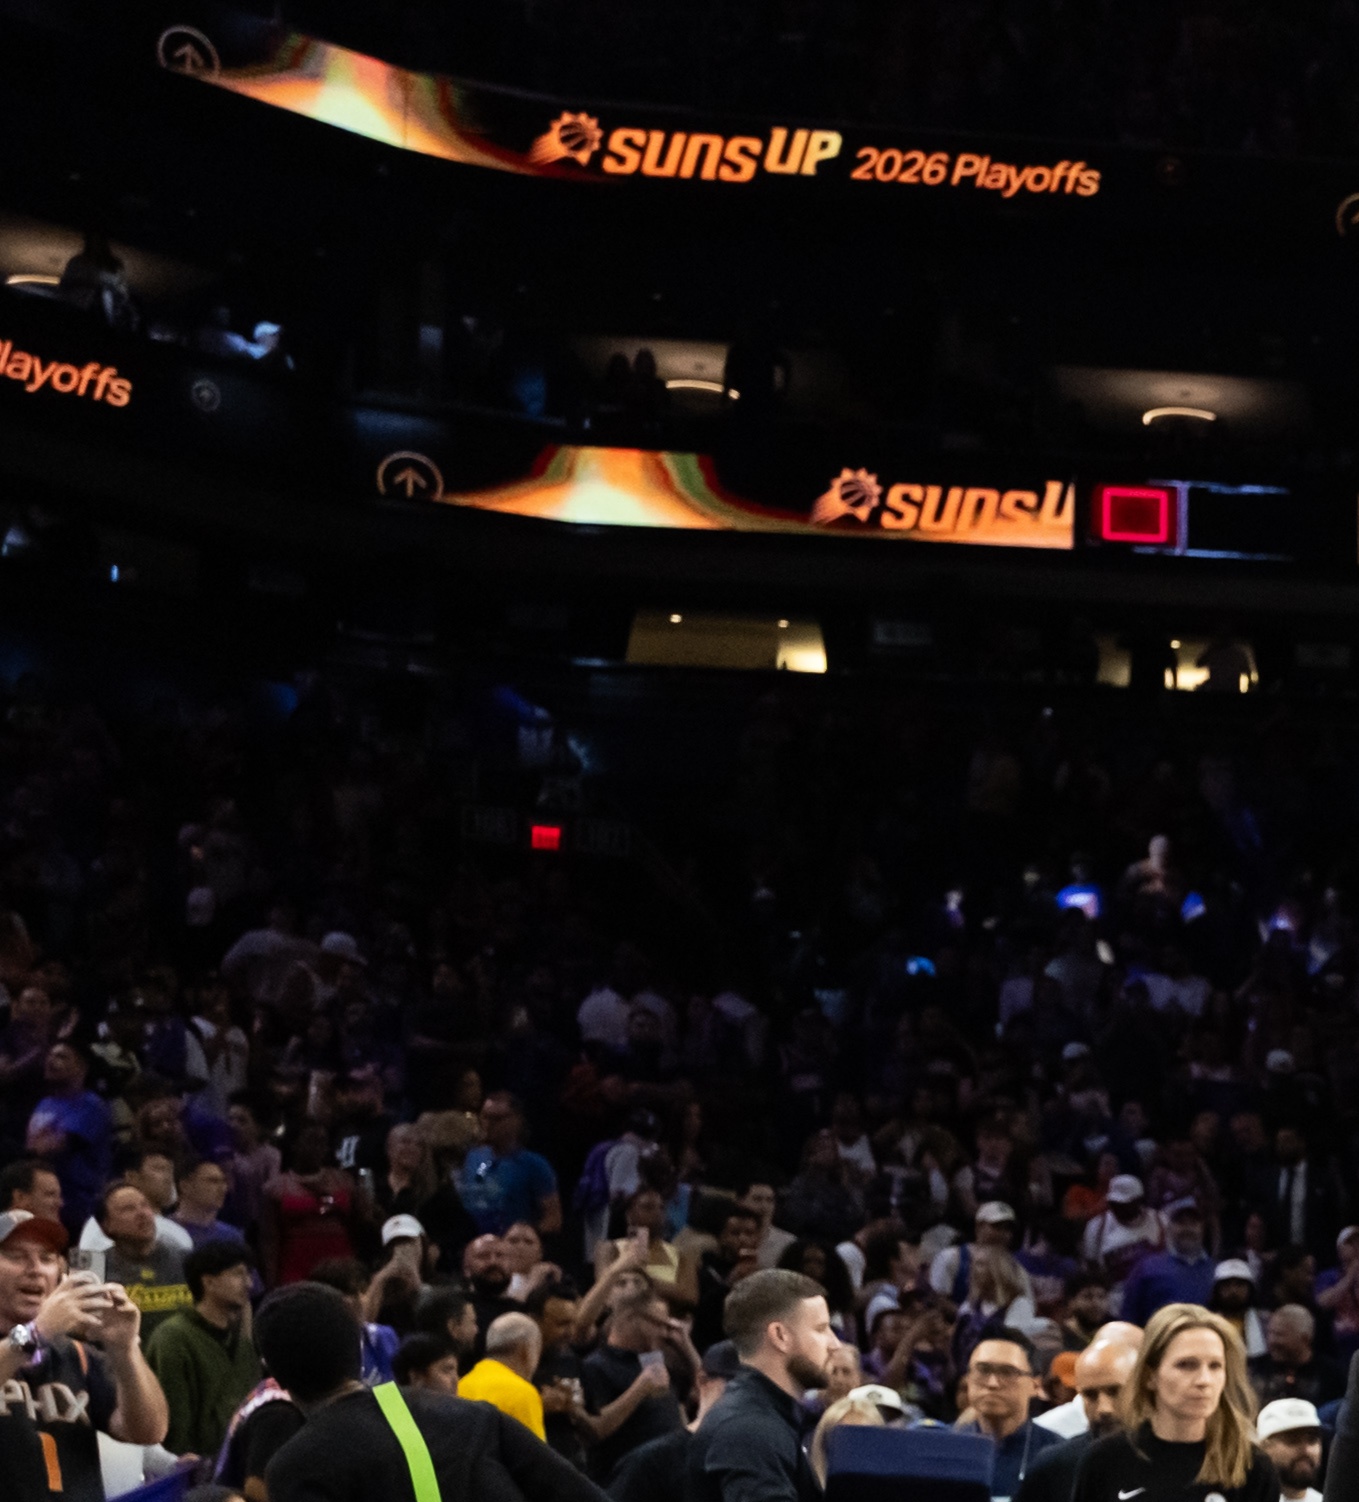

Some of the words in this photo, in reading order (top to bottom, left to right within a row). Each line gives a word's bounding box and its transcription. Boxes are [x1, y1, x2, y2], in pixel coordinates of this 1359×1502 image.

[850, 146, 947, 186] 2026
[950, 153, 1100, 198] Playoffs
[0, 338, 133, 407] layoffs
